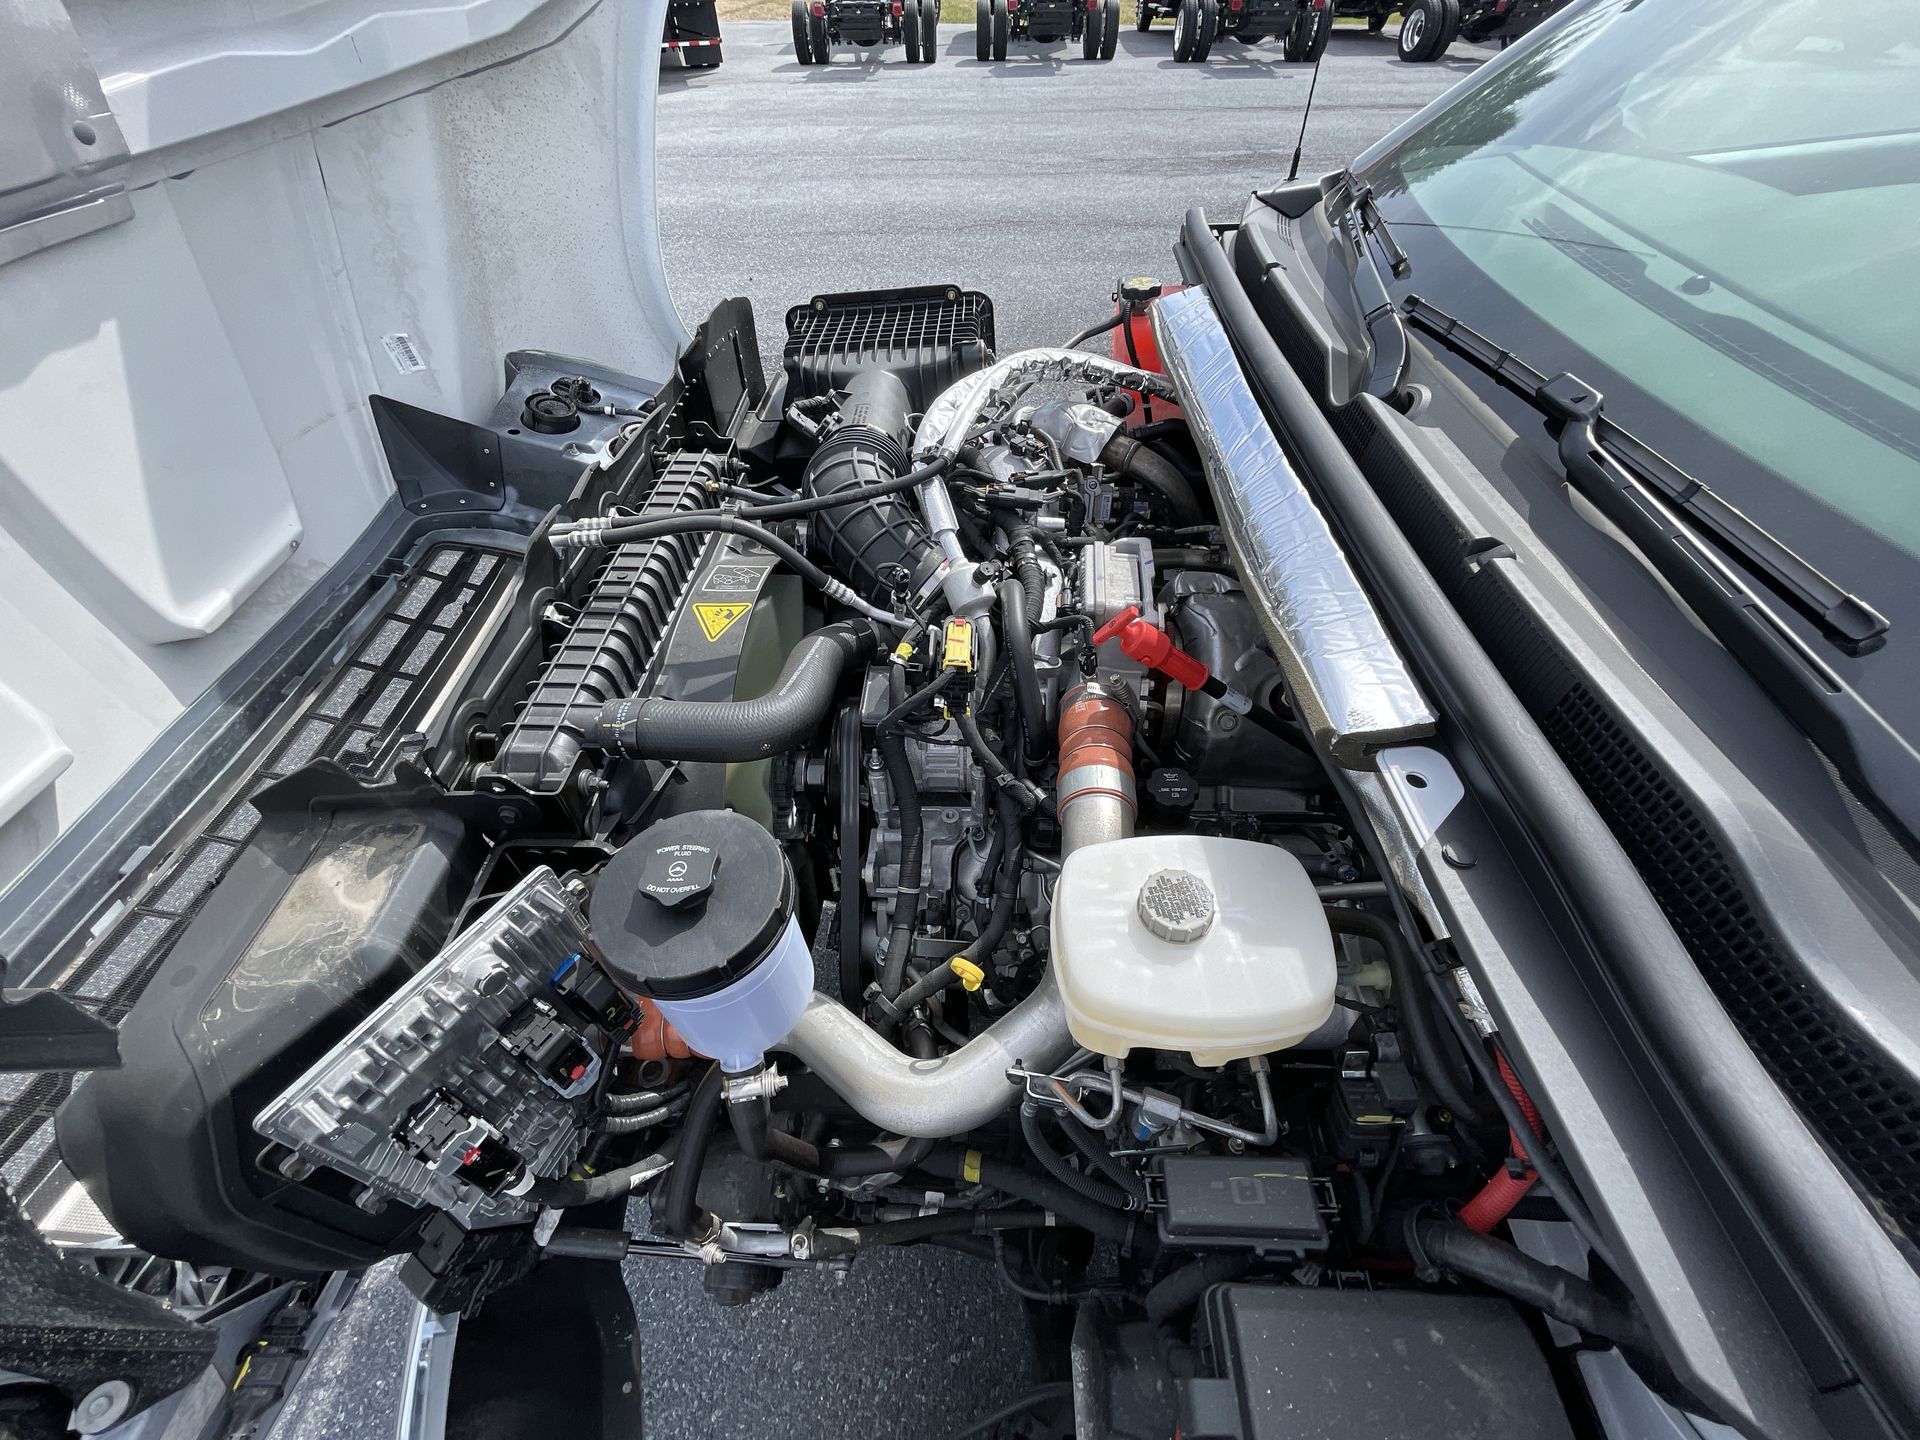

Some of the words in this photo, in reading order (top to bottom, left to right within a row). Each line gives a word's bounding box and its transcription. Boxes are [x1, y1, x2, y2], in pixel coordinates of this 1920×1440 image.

[657, 845, 680, 854] POWER
[682, 845, 710, 853] STEERING
[670, 884, 700, 893] OVERFILL
